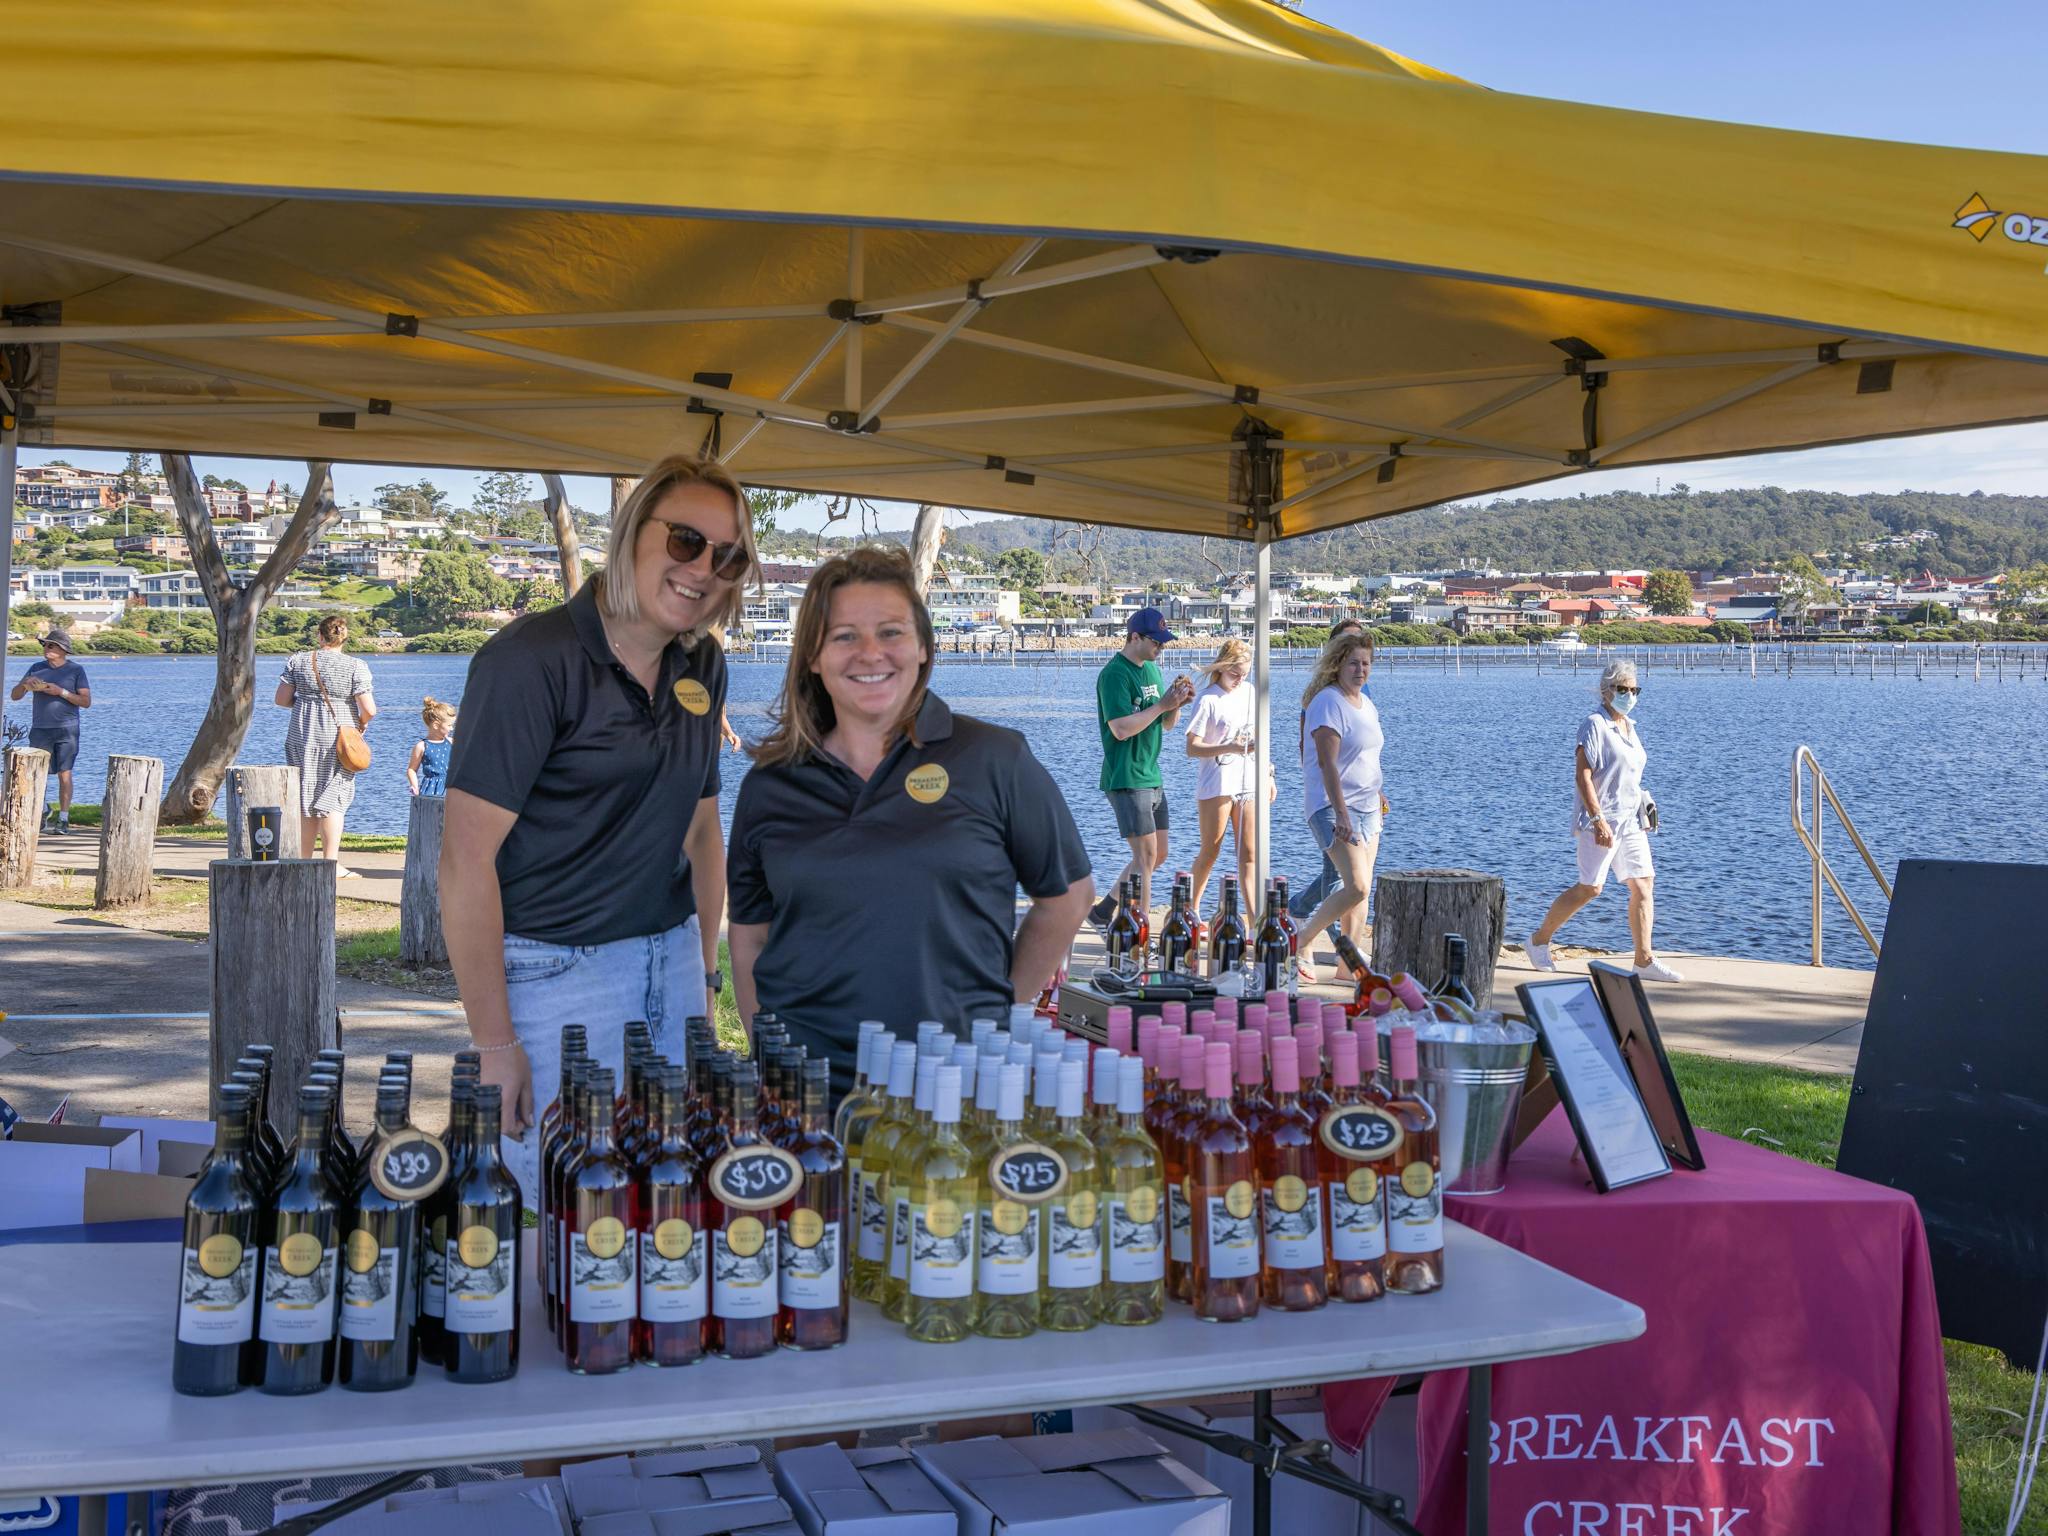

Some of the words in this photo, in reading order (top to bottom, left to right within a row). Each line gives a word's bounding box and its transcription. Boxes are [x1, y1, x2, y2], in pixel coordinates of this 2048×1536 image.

[909, 775, 946, 783] BREAKFAST
[1340, 1118, 1389, 1147] $25
[727, 1159, 787, 1196] $30
[999, 1161, 1056, 1193] $25
[207, 1255, 233, 1263] CREEK
[1523, 1500, 1750, 1536] CREEK
